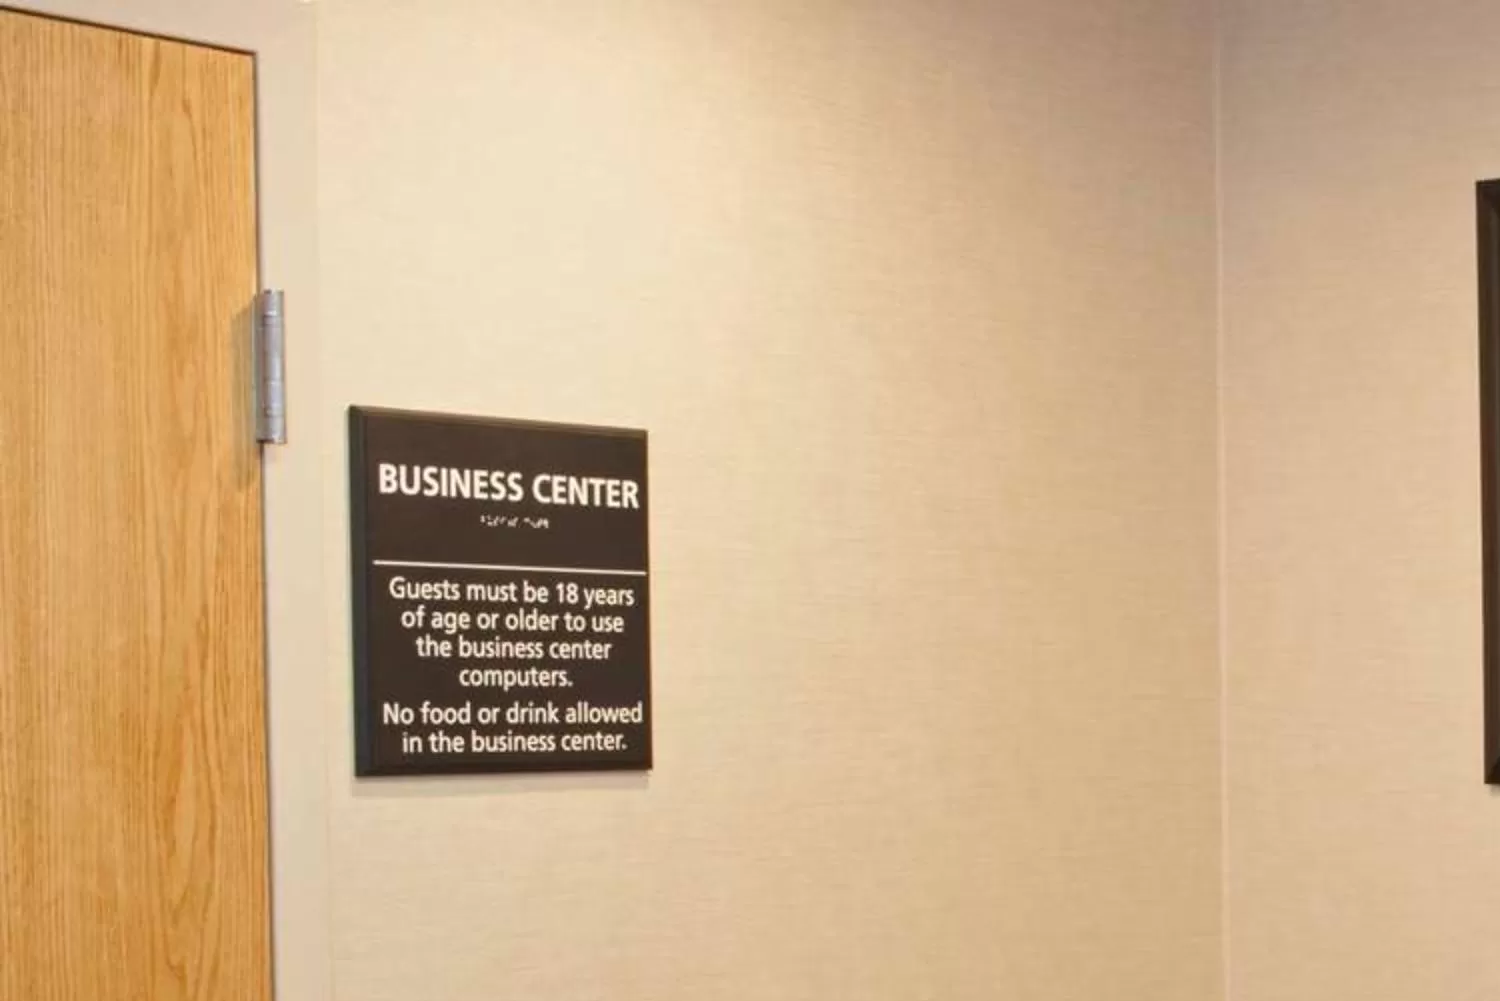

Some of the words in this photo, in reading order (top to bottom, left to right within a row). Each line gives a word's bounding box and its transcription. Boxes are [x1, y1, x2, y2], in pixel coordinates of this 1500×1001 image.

[378, 462, 525, 502] BUSINESS
[531, 473, 640, 510] CENTER
[388, 575, 461, 601] Guests
[466, 580, 518, 603] must
[522, 579, 550, 604] be
[555, 582, 579, 605] 18
[583, 587, 635, 611] years
[400, 604, 426, 629] of
[430, 611, 471, 635] age
[476, 612, 500, 630] or
[504, 607, 559, 632] older
[563, 611, 587, 633] to
[591, 615, 625, 633] use
[415, 633, 453, 658] the
[458, 634, 545, 659] business
[548, 639, 613, 660] center
[458, 666, 574, 692] computers.
[383, 702, 415, 725] No
[419, 700, 472, 725] food
[477, 707, 501, 725] or
[505, 700, 560, 724] drink
[564, 700, 643, 724] allowed
[402, 731, 423, 753] in
[427, 730, 465, 753] the
[471, 729, 557, 753] business
[560, 731, 628, 752] center.
